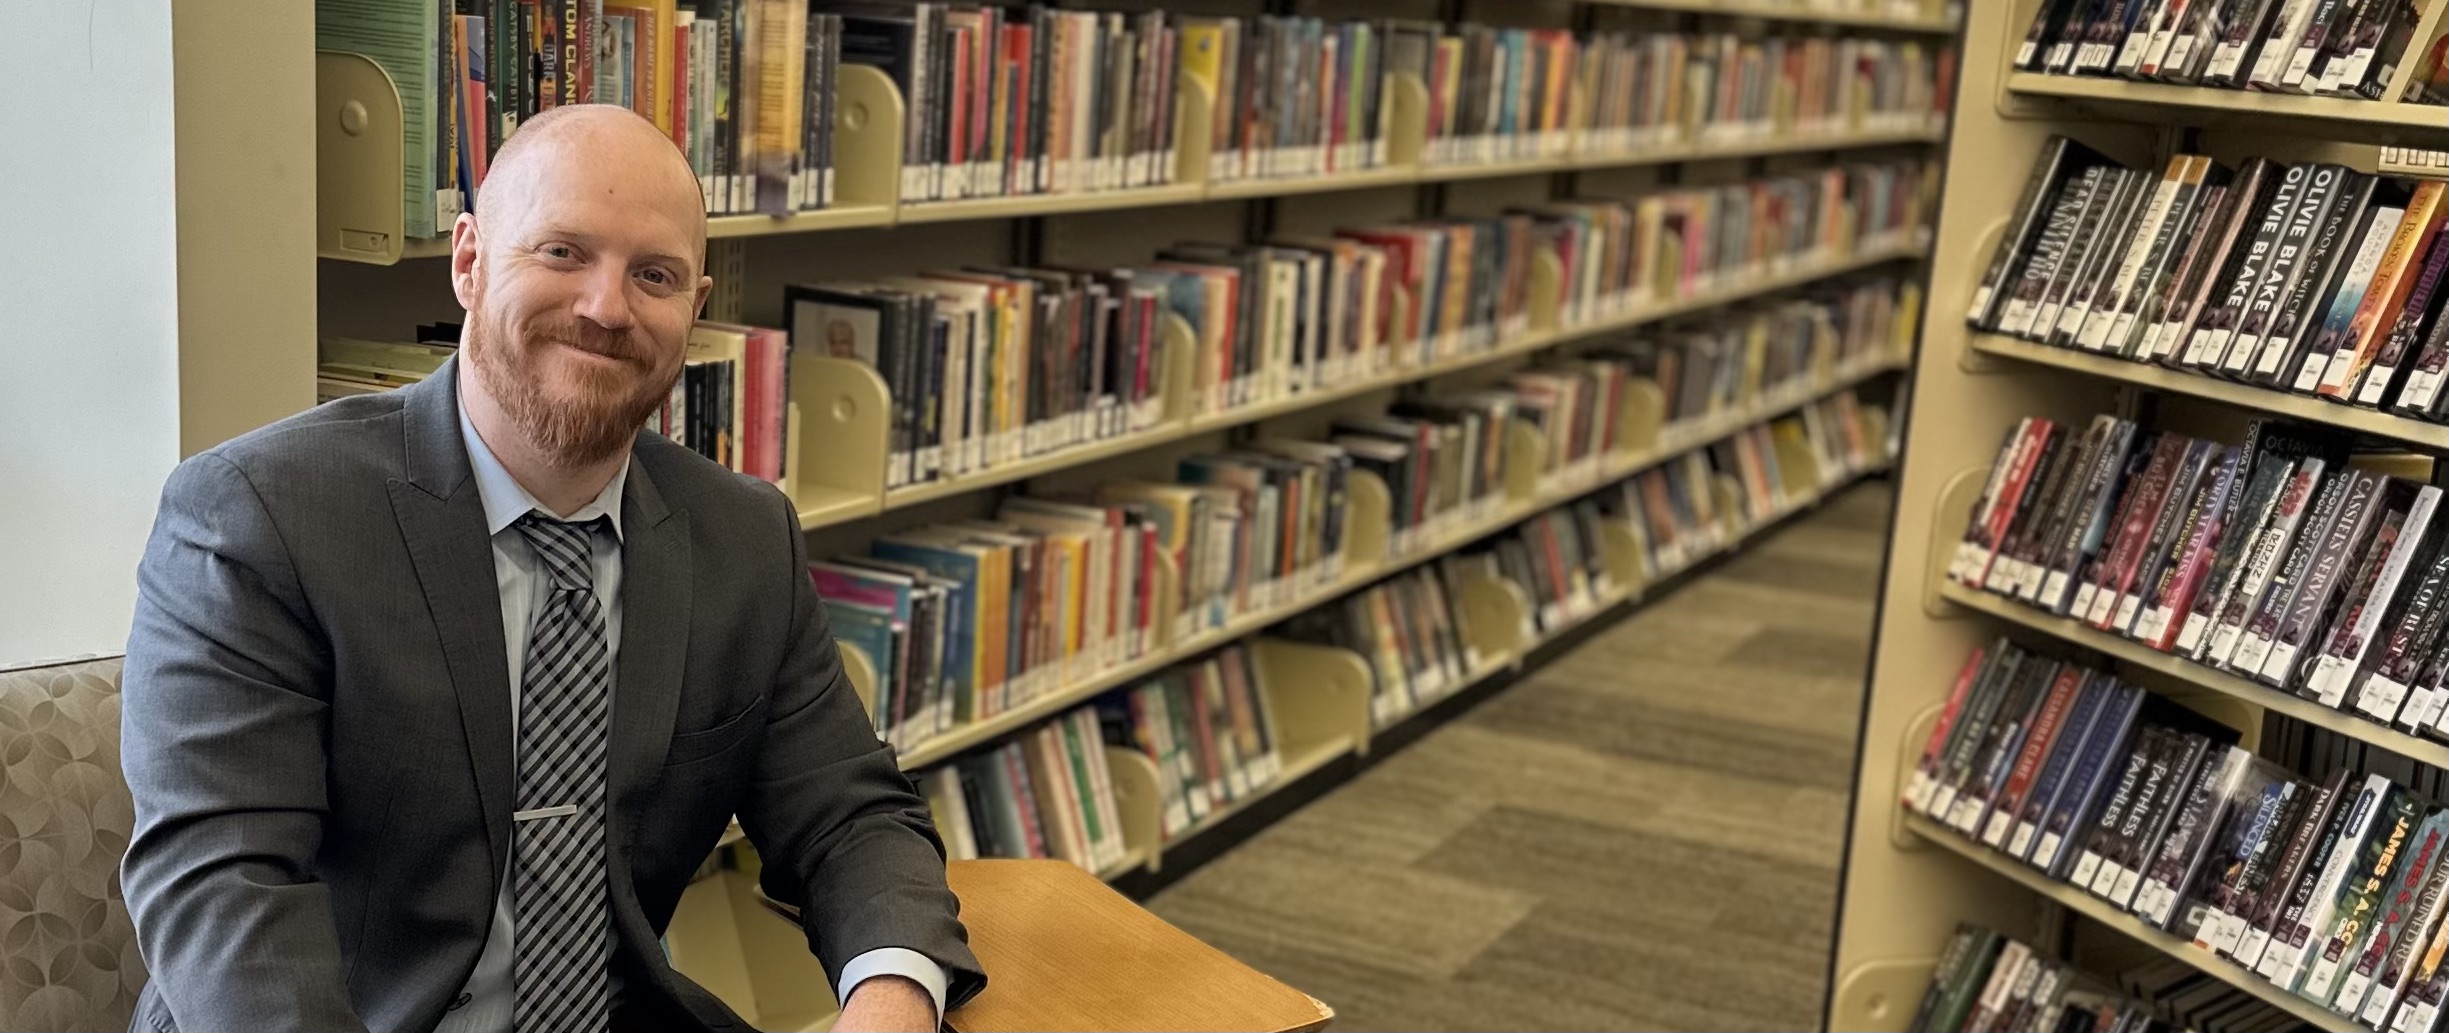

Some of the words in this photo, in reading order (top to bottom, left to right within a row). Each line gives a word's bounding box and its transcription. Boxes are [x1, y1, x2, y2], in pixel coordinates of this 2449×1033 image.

[565, 0, 576, 38] TOM
[584, 15, 592, 68] ANDREWS
[2135, 198, 2163, 244] PETER
[2260, 163, 2305, 236] OLIVIE
[2287, 166, 2334, 240] OLIVIE
[2154, 200, 2184, 246] PETER
[2111, 262, 2132, 292] BEA
[2130, 265, 2152, 296] BEA
[2225, 237, 2270, 310] BLAKE
[2252, 241, 2298, 315] BLAKE
[2285, 276, 2312, 317] WITCH
[2176, 463, 2192, 486] JIM
[2311, 477, 2335, 515] ORSON
[2322, 471, 2349, 515] ORSON
[2151, 485, 2183, 544] BUTCHER
[2193, 487, 2208, 507] JIM
[2169, 507, 2199, 560] BUTCHER
[2295, 514, 2317, 548] SCOTT
[2302, 514, 2328, 555] SCOTT
[2139, 550, 2155, 577] PEAC
[2174, 549, 2194, 579] KISS
[2282, 546, 2301, 575] CARD
[2286, 553, 2309, 586] CARD
[2426, 552, 2449, 586] SEA
[2270, 602, 2284, 620] LAS
[2289, 552, 2336, 629] SERVANT
[2389, 612, 2420, 657] RUST
[2032, 675, 2072, 745] CASSANDRA
[2015, 742, 2041, 781] CLARE
[2100, 753, 2146, 830] FAITHLESS
[2120, 762, 2166, 839] FAITHLESS
[2308, 787, 2330, 821] DARK
[2237, 792, 2277, 858] SILENCED
[2372, 814, 2410, 877] JAMES
[2279, 820, 2314, 881] BREAKERS
[2312, 831, 2335, 868] COOPER
[2404, 826, 2443, 890] JAMES
[2302, 848, 2344, 924] CONVERGENCE
[2351, 896, 2370, 919] A.
[2361, 875, 2381, 898] S.
[2401, 884, 2440, 947] RUINED
